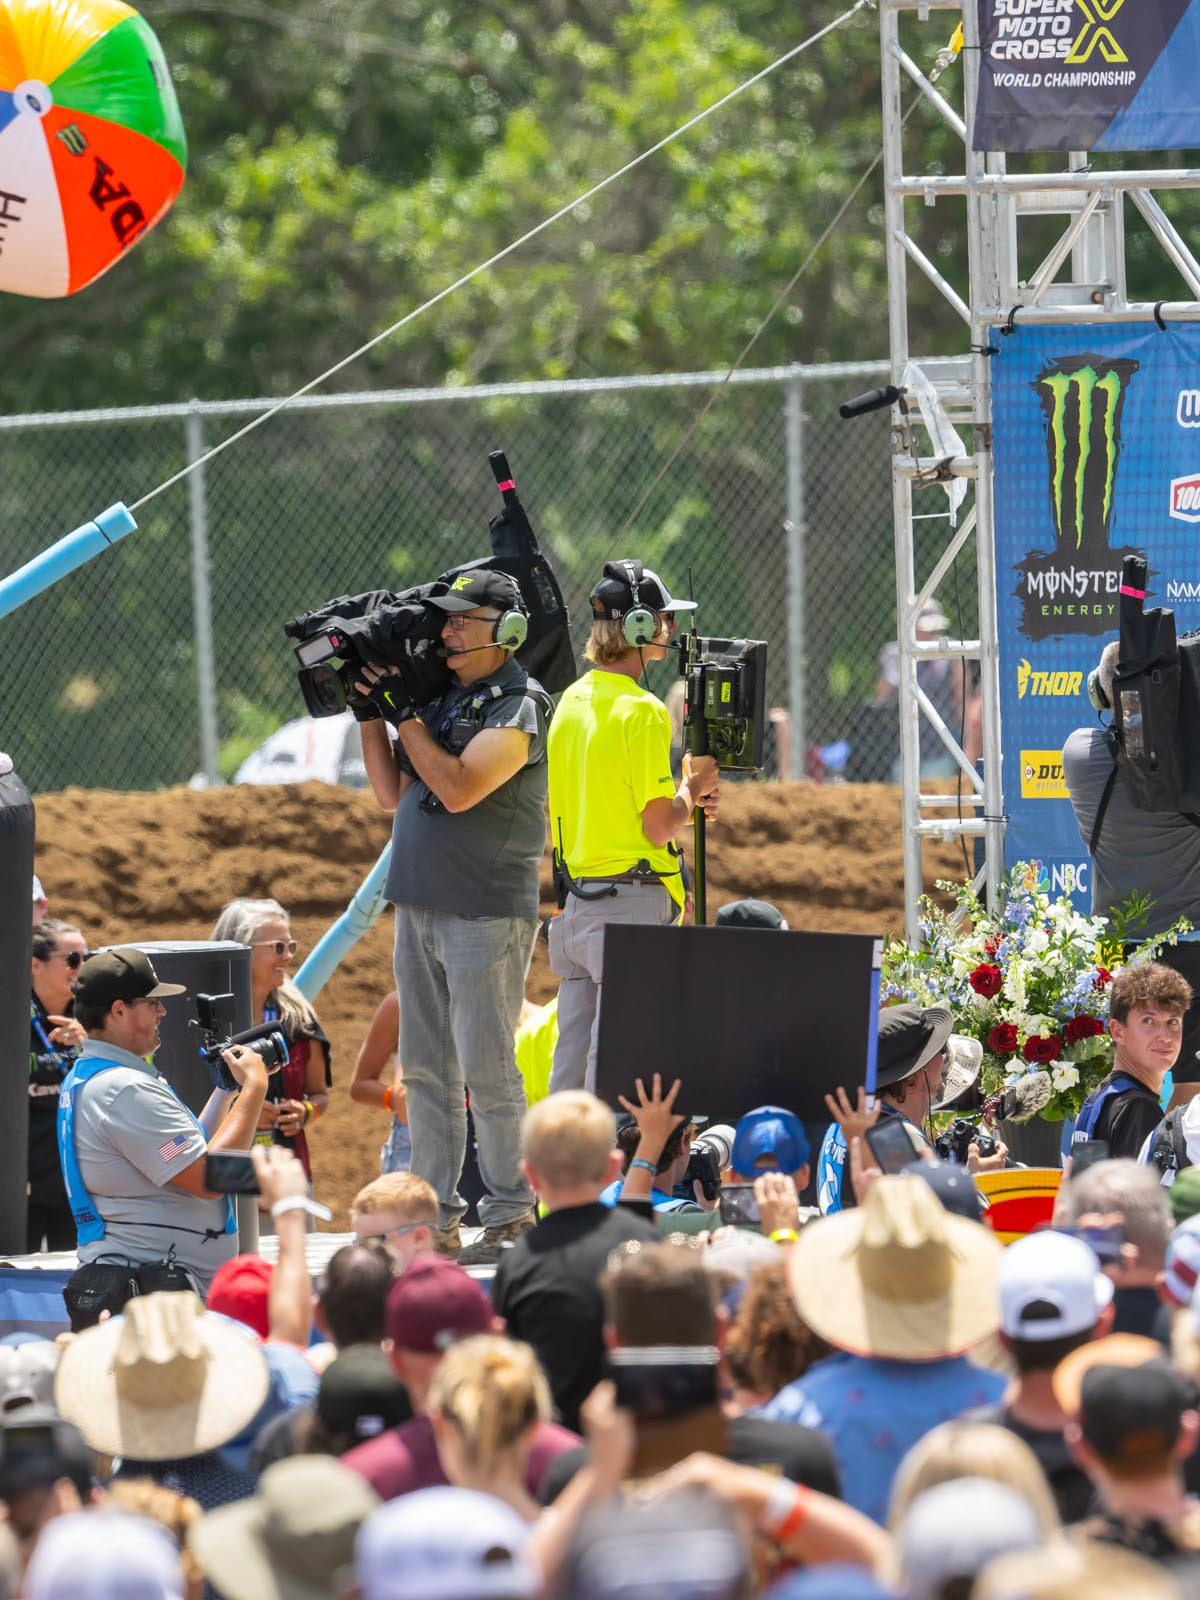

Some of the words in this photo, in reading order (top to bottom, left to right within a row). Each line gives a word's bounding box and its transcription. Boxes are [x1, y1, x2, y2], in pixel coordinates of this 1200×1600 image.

[998, 15, 1071, 38] MOTO
[990, 37, 1073, 60] CROSS
[992, 73, 1042, 87] WORLD
[1043, 71, 1137, 87] CHAMPIONSHIP
[1041, 604, 1115, 616] ENERGY
[1030, 671, 1083, 696] THOR
